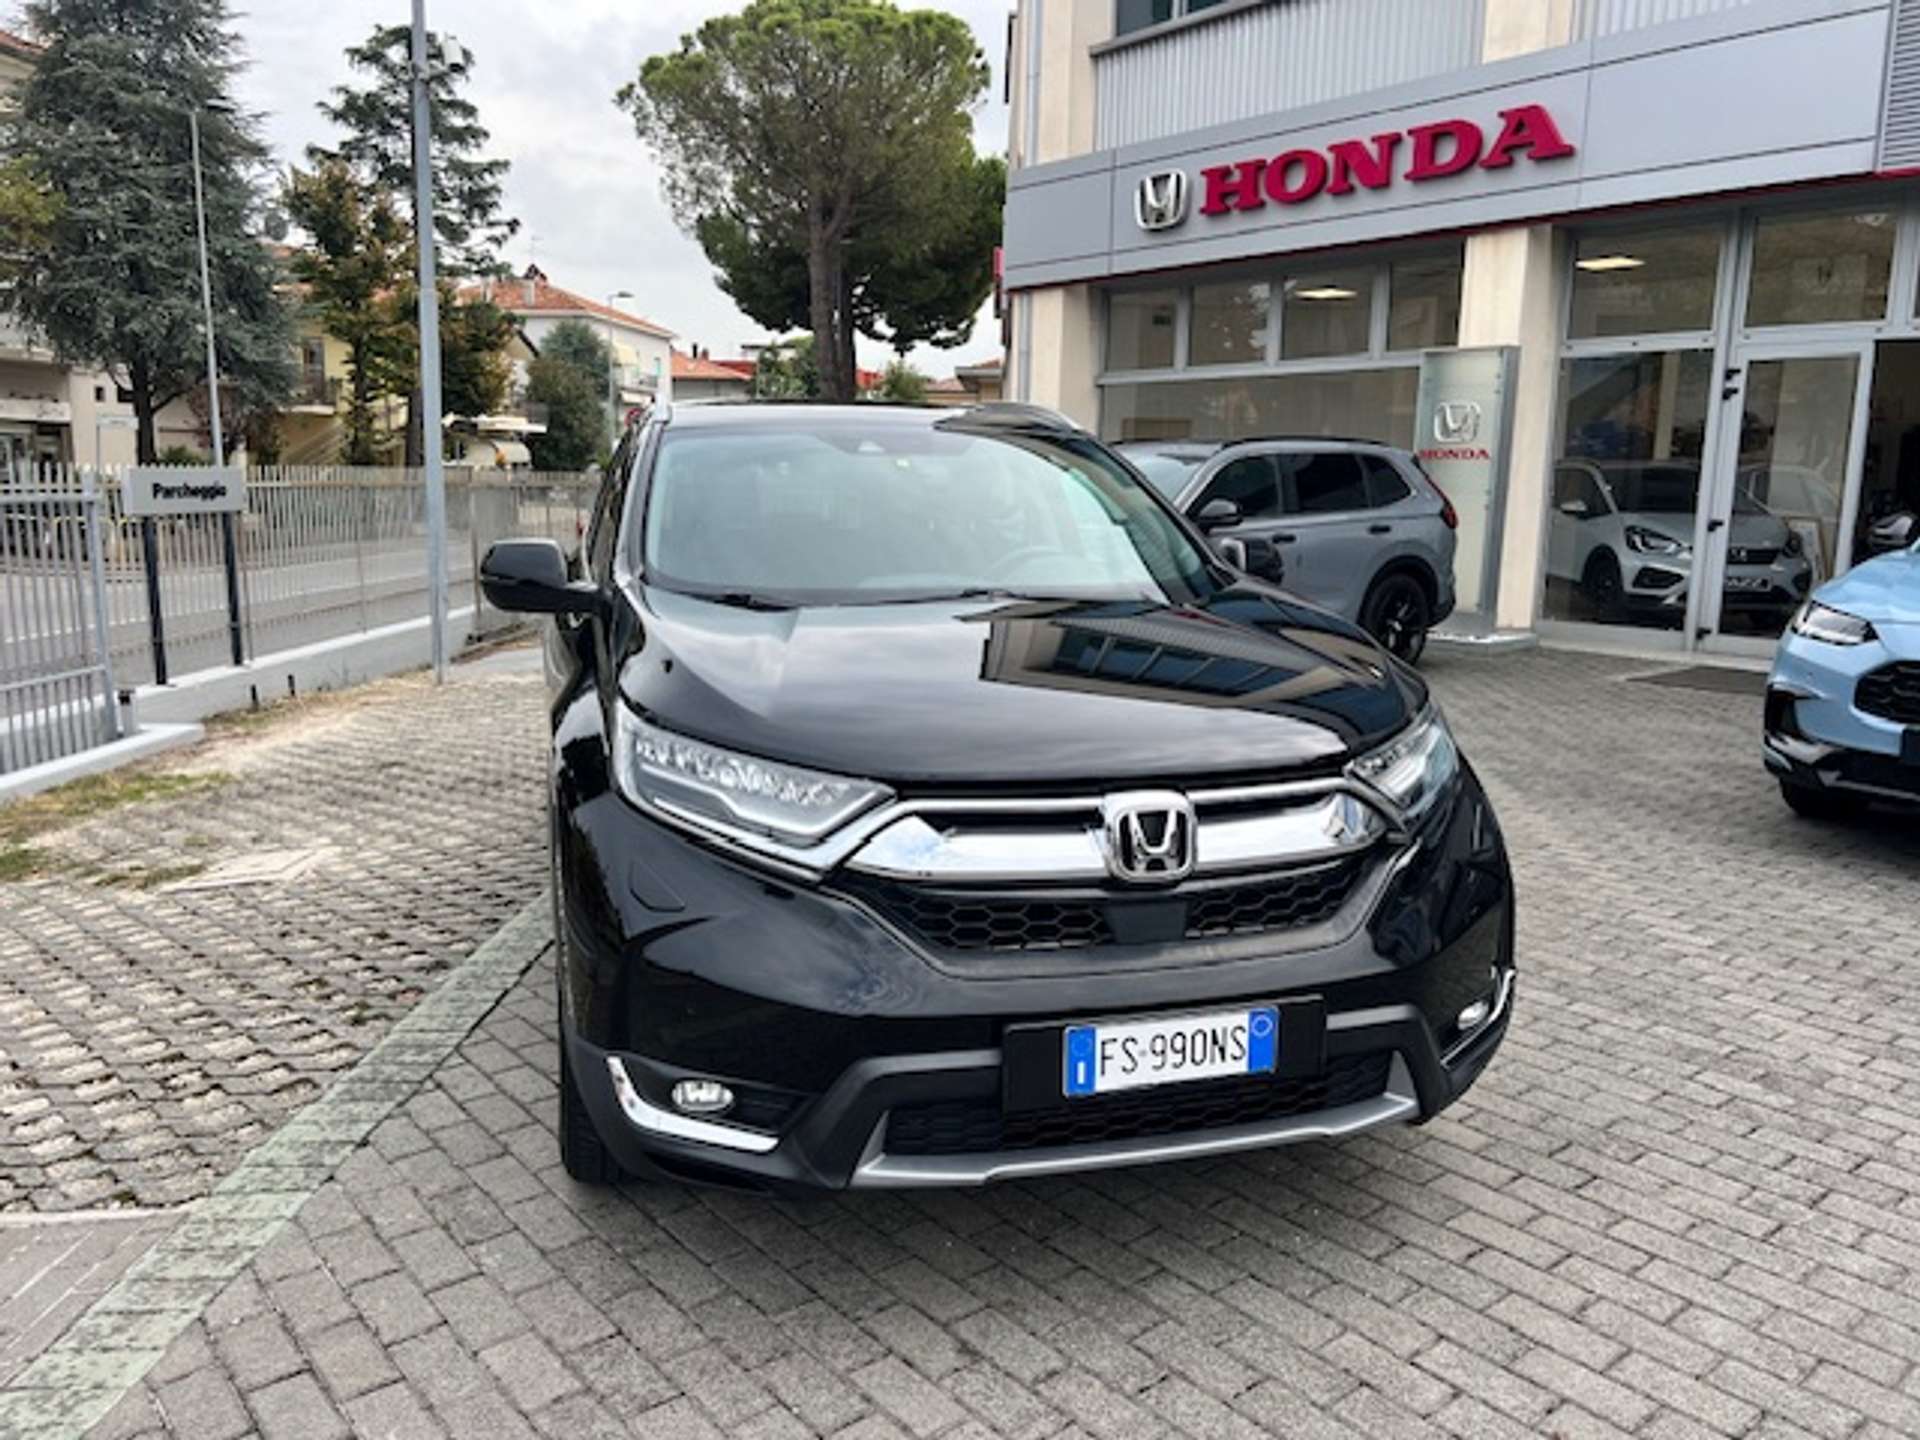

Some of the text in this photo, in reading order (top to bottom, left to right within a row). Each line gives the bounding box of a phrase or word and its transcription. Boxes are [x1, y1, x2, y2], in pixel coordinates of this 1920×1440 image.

[1199, 103, 1576, 216] HONDA
[1417, 448, 1489, 460] HONDA
[152, 482, 227, 501] Parcheggio
